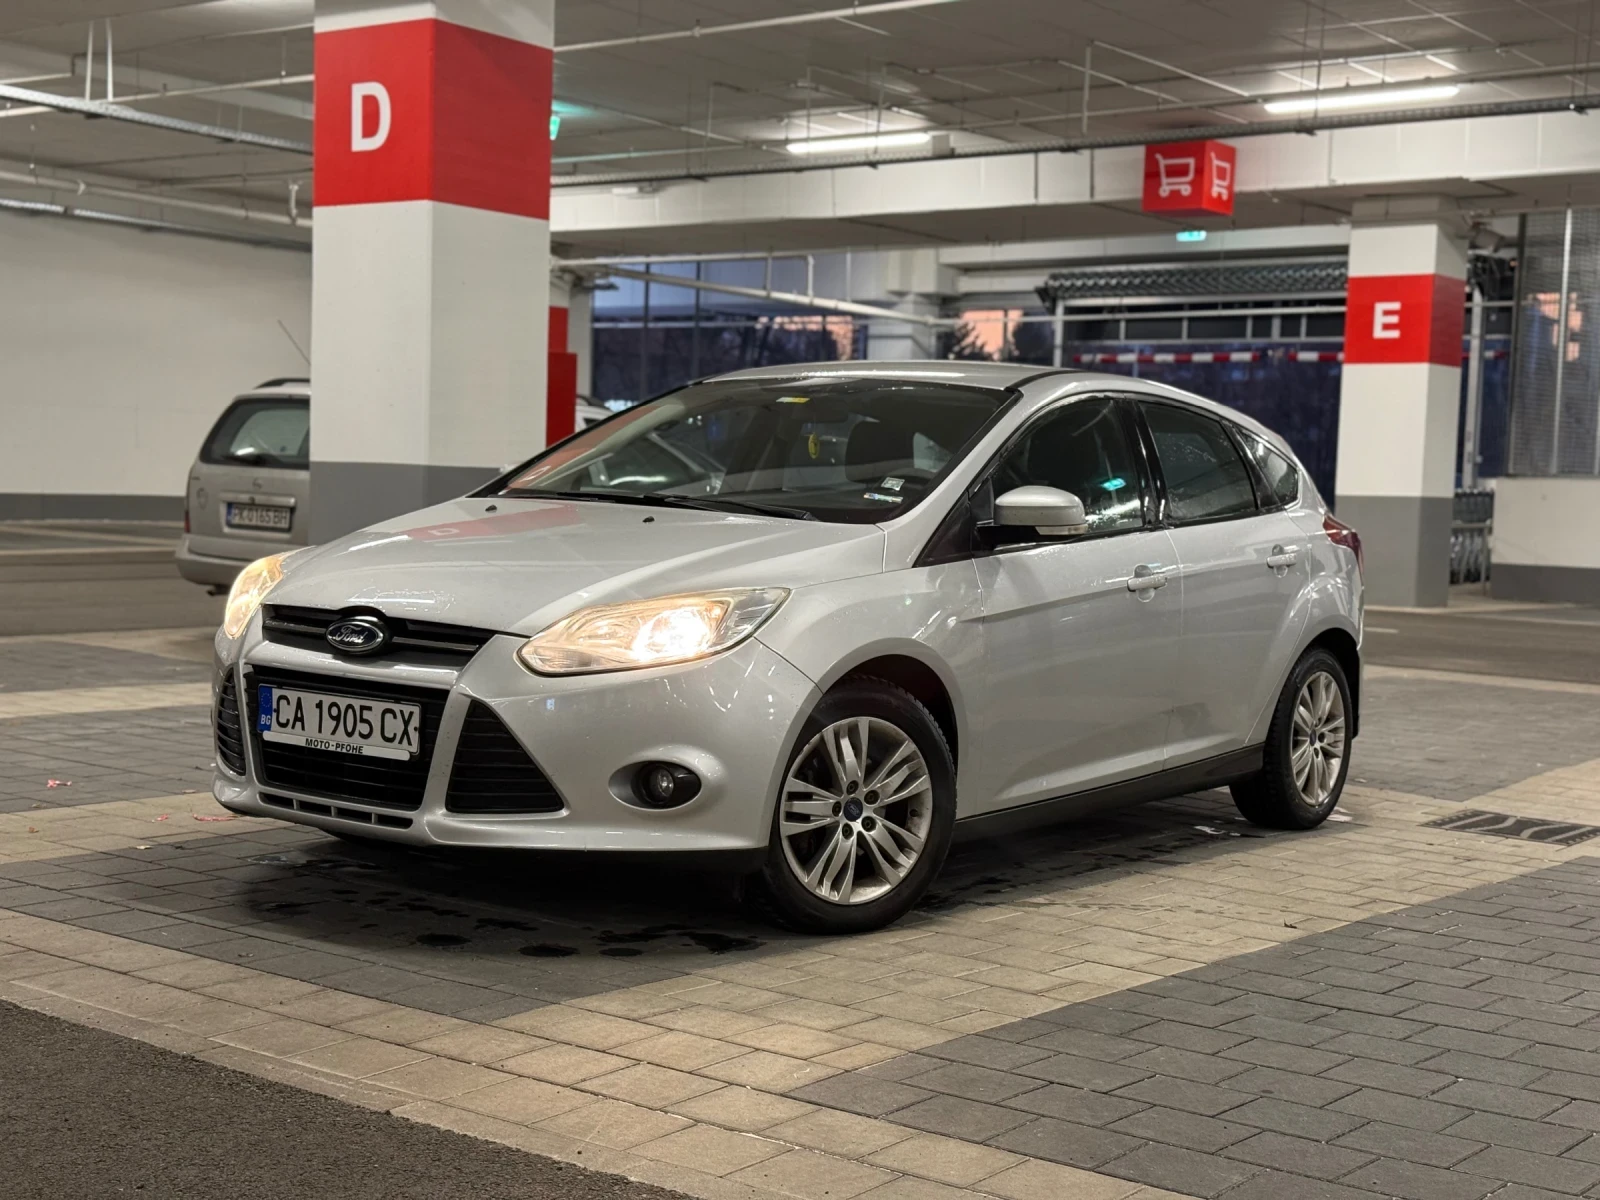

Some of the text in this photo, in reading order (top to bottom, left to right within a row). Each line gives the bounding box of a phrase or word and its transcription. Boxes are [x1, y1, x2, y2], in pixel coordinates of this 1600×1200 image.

[351, 81, 392, 152] D
[1372, 301, 1402, 339] E
[336, 625, 369, 643] Ford
[260, 714, 271, 726] BG
[276, 694, 414, 746] CA 1905 CX
